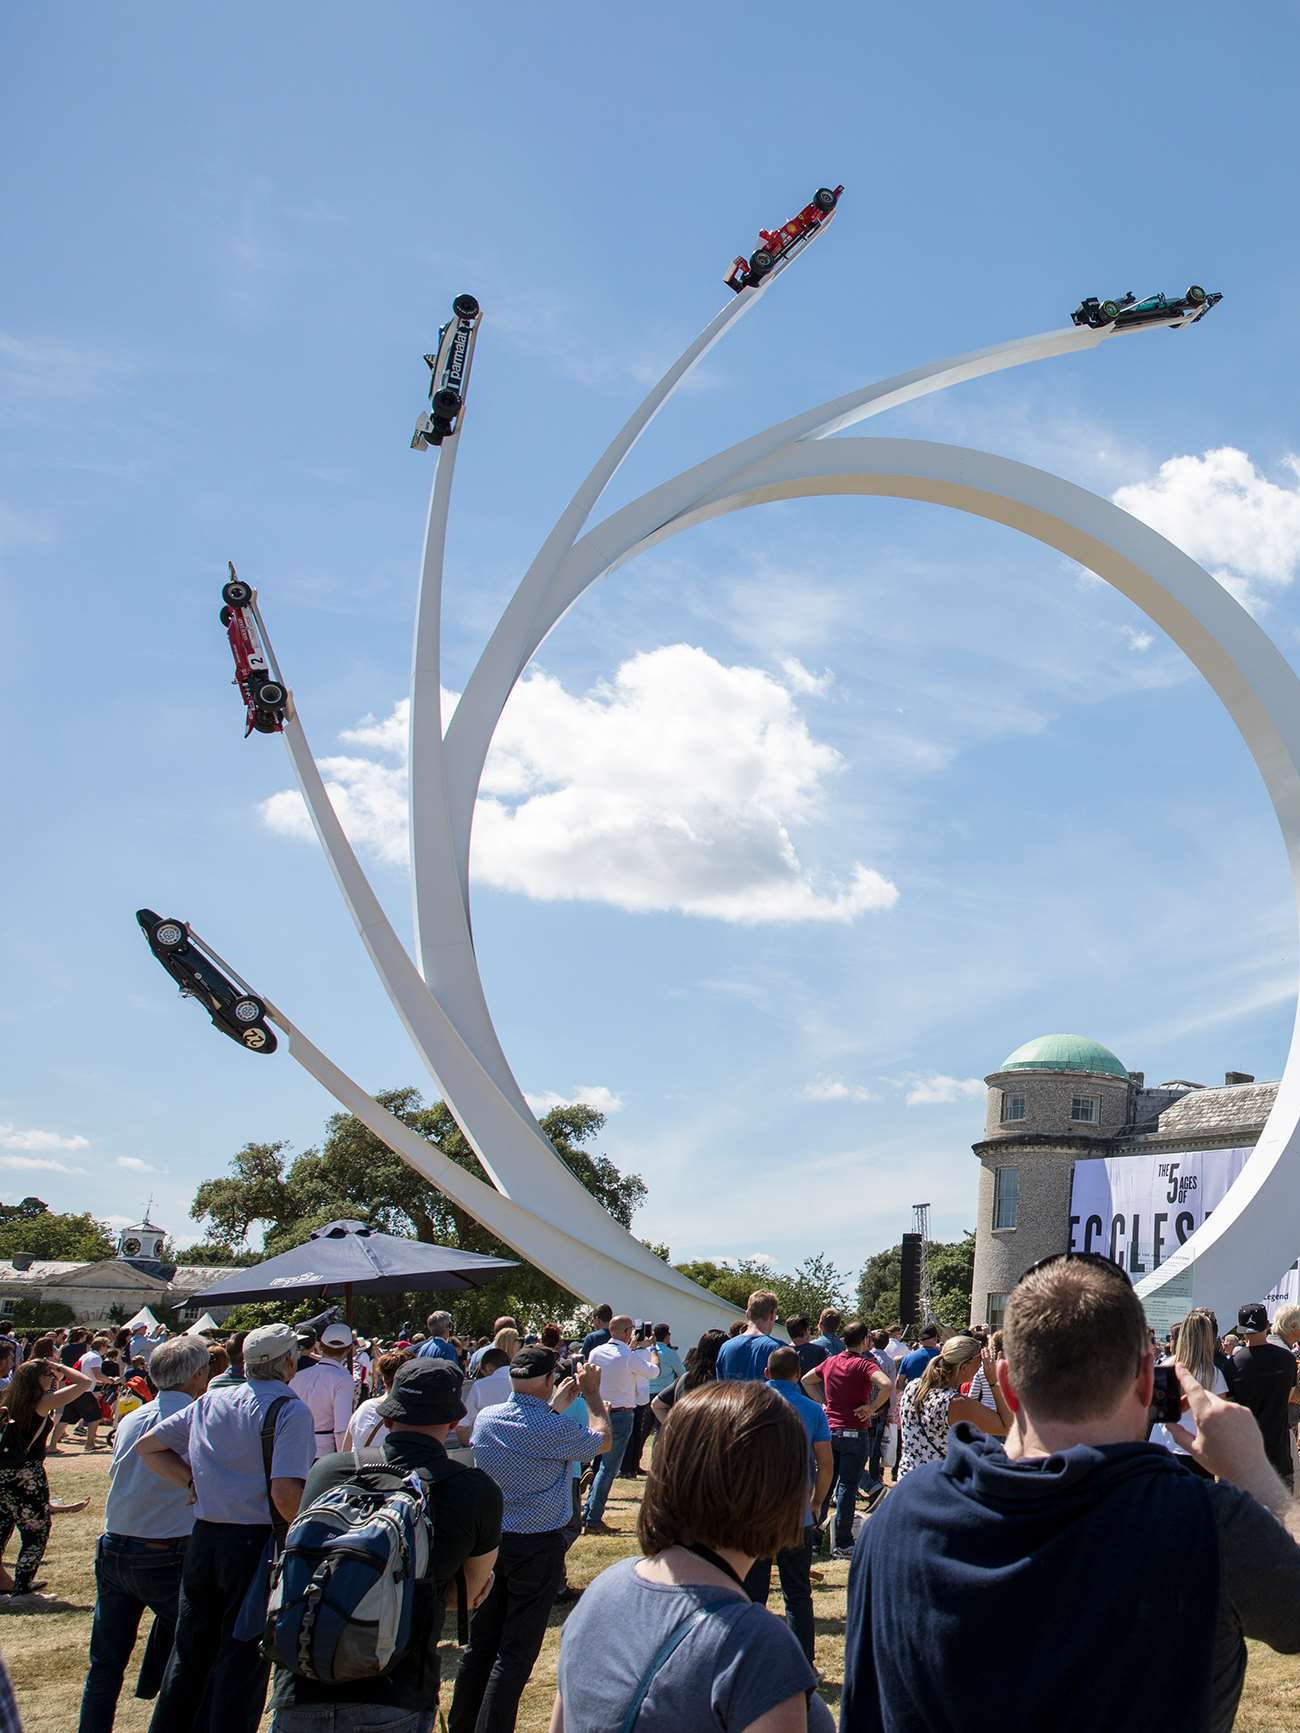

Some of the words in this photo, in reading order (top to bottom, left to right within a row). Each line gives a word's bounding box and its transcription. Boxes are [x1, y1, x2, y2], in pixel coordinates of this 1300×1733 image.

[451, 330, 468, 380] parmalat
[250, 657, 263, 665] 2
[245, 1030, 264, 1046] 22
[1158, 1164, 1169, 1177] THE
[1167, 1163, 1181, 1204] 5
[1179, 1176, 1197, 1190] AGES
[1178, 1190, 1188, 1204] OF
[1069, 1211, 1213, 1273] ECCLES
